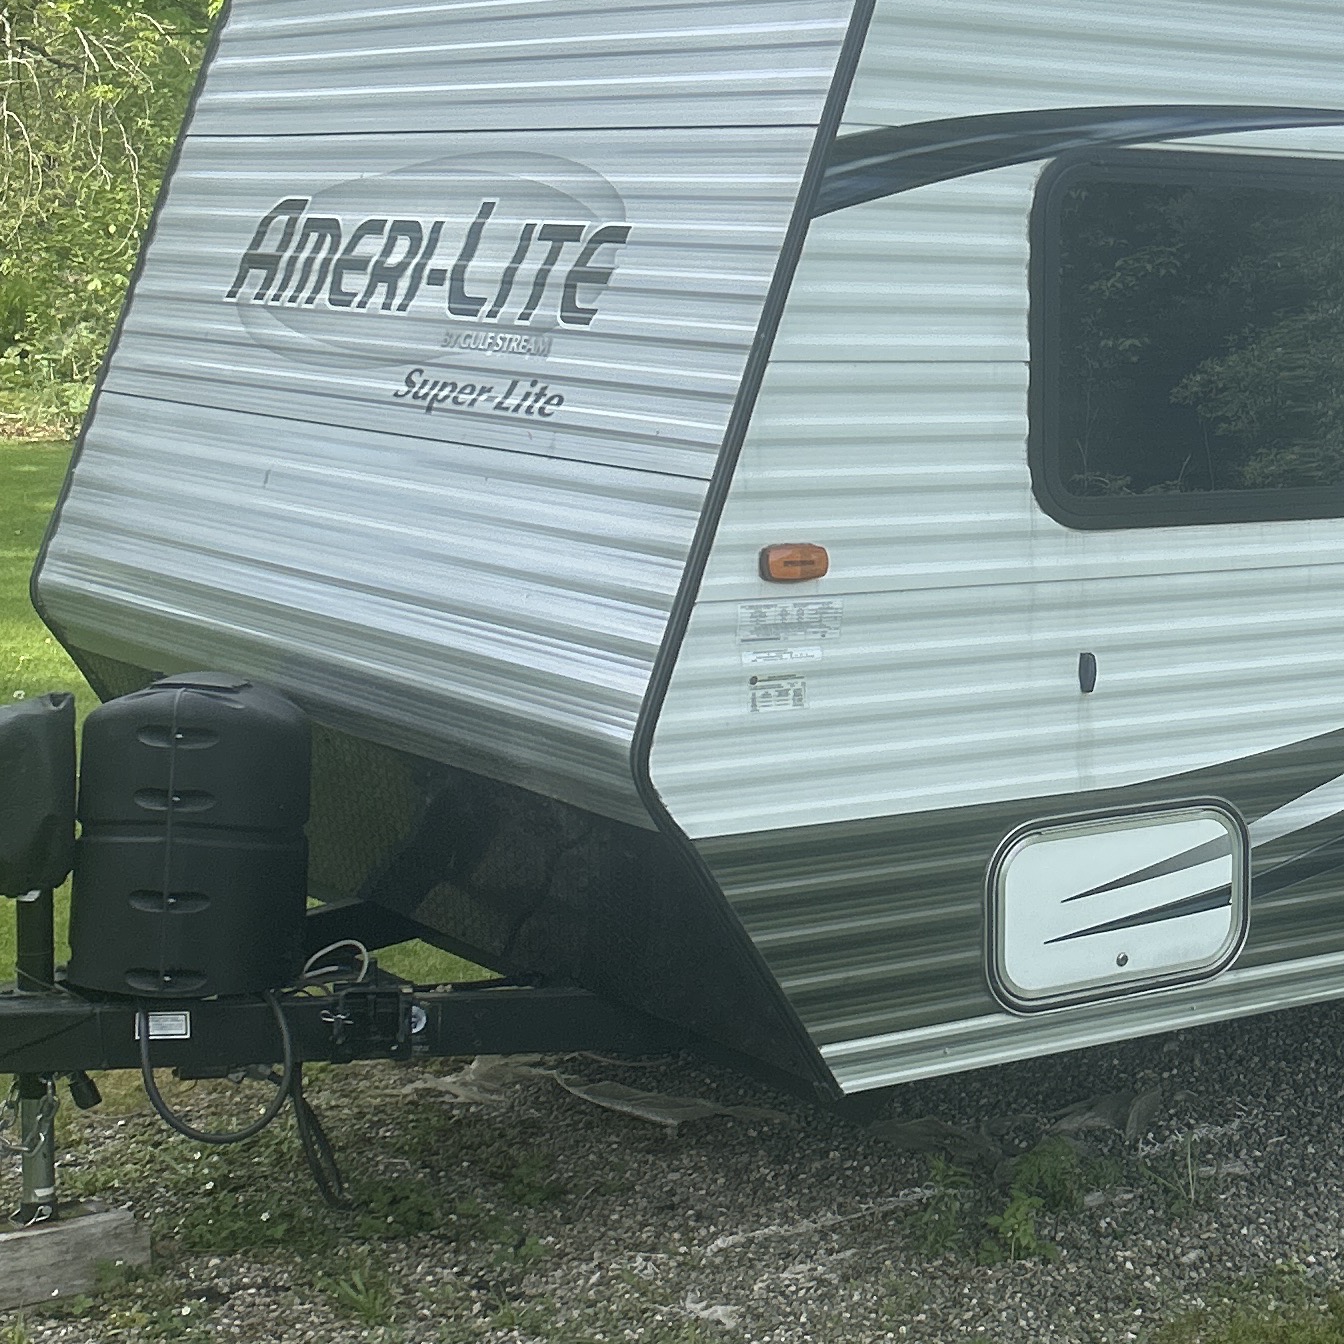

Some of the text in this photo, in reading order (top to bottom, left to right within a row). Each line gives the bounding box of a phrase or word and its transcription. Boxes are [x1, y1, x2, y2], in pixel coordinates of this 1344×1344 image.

[224, 197, 633, 328] AMERI-LITE
[460, 331, 495, 351] GULF
[493, 333, 552, 357] STREAM
[393, 367, 566, 418] Super-Lite
